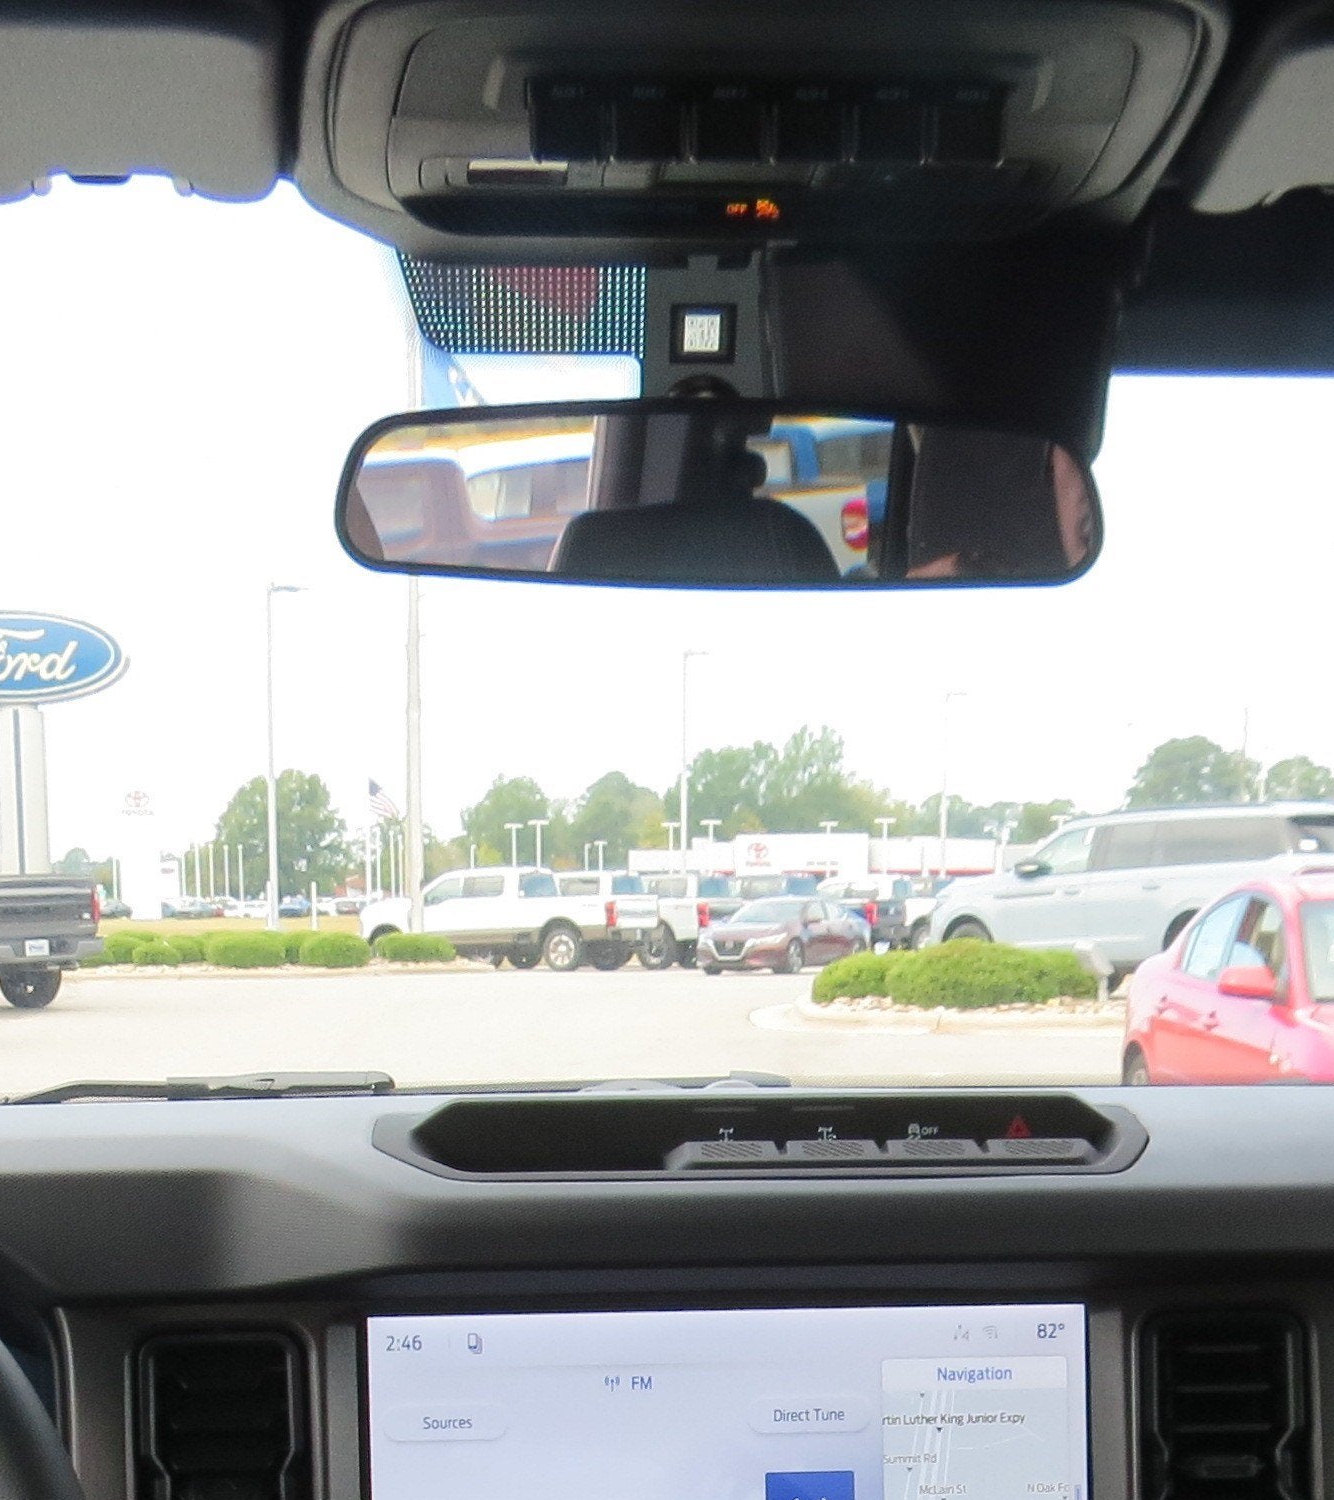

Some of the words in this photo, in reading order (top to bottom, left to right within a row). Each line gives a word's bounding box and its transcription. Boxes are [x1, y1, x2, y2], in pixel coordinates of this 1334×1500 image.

[920, 1125, 939, 1136] OFF
[1036, 1323, 1065, 1340] 82°
[385, 1335, 423, 1352] 2:46
[936, 1365, 1013, 1383] Navigation
[630, 1375, 653, 1391] FM
[772, 1408, 810, 1422] Direct
[813, 1407, 845, 1422] Tune
[902, 1413, 938, 1425] Luther
[940, 1412, 964, 1427] King
[966, 1412, 998, 1424] Junior
[422, 1415, 474, 1430] Sources
[882, 1453, 921, 1465] Summit
[923, 1453, 937, 1464] Rd
